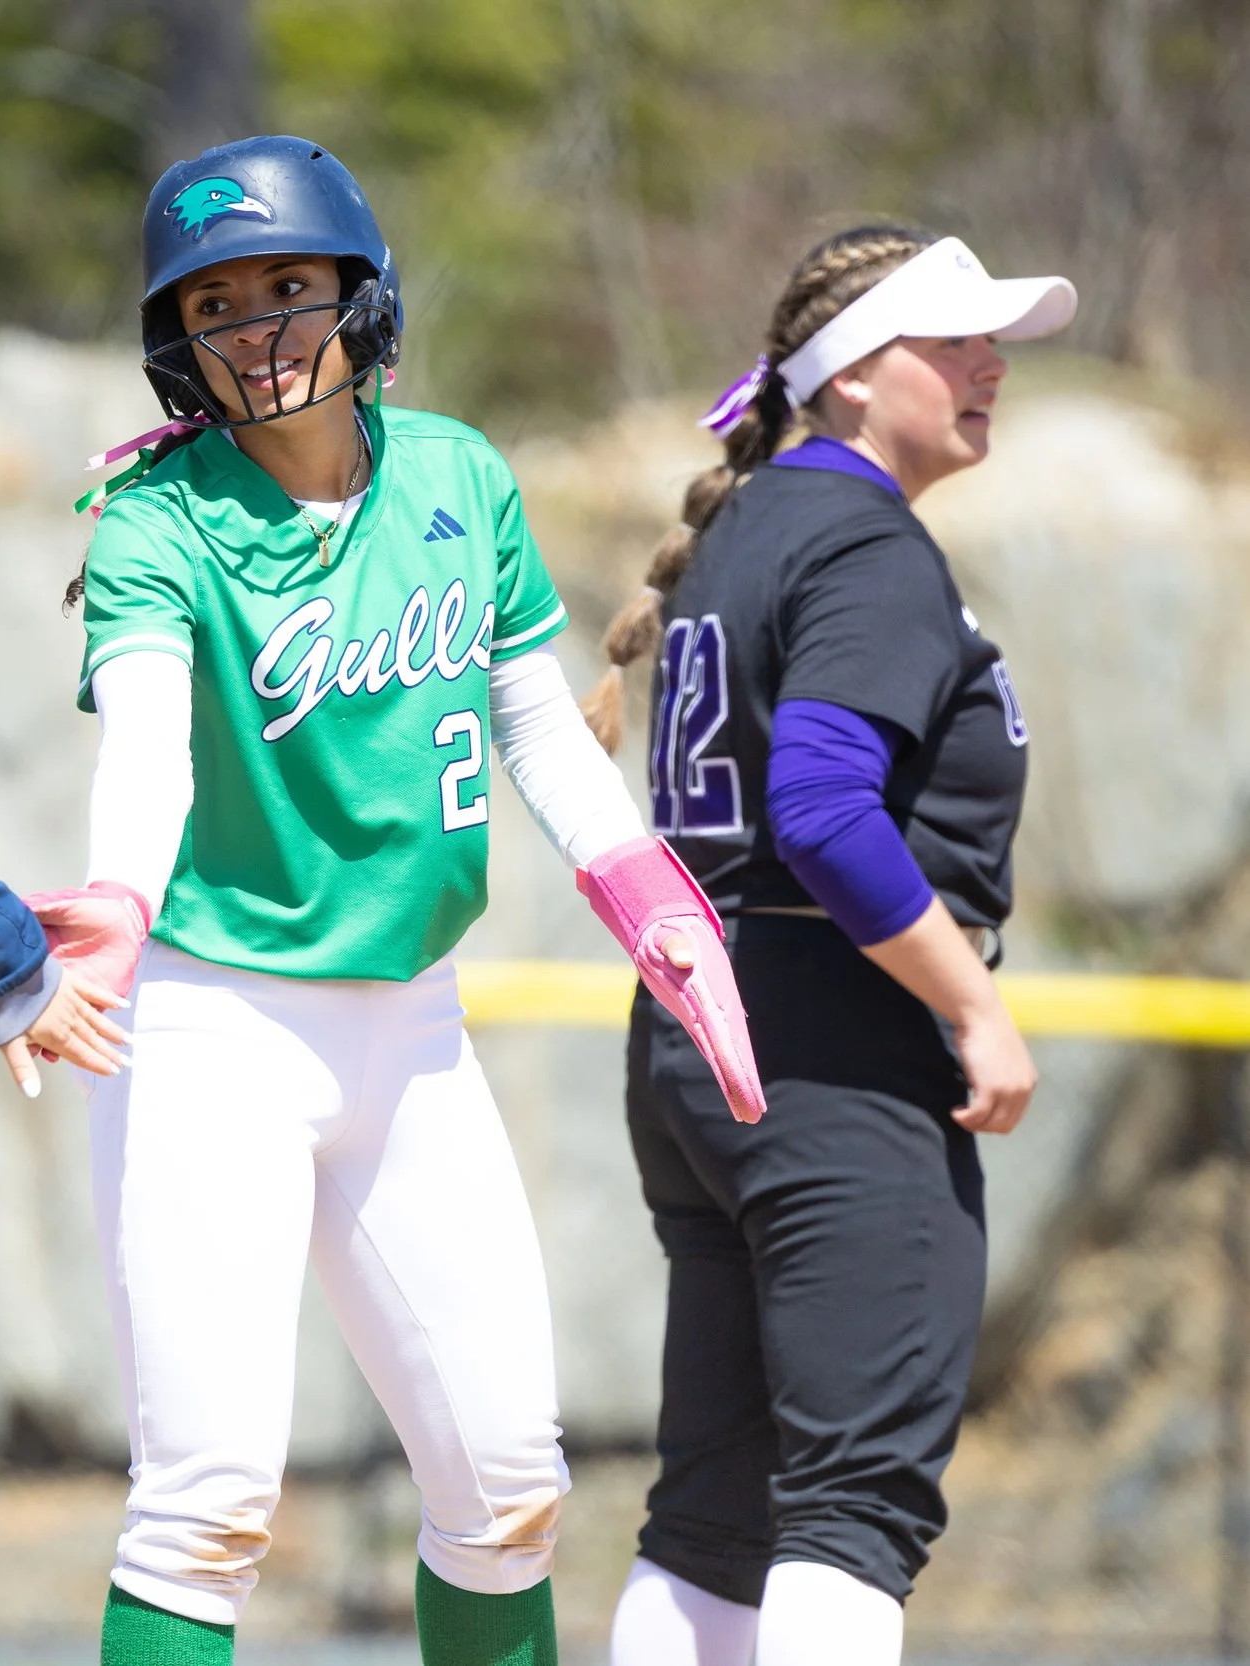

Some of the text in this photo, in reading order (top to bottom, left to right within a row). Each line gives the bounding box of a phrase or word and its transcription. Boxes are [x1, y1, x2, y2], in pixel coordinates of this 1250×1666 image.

[250, 577, 495, 742] Gulls
[651, 613, 744, 838] 12
[433, 707, 492, 834] 2
